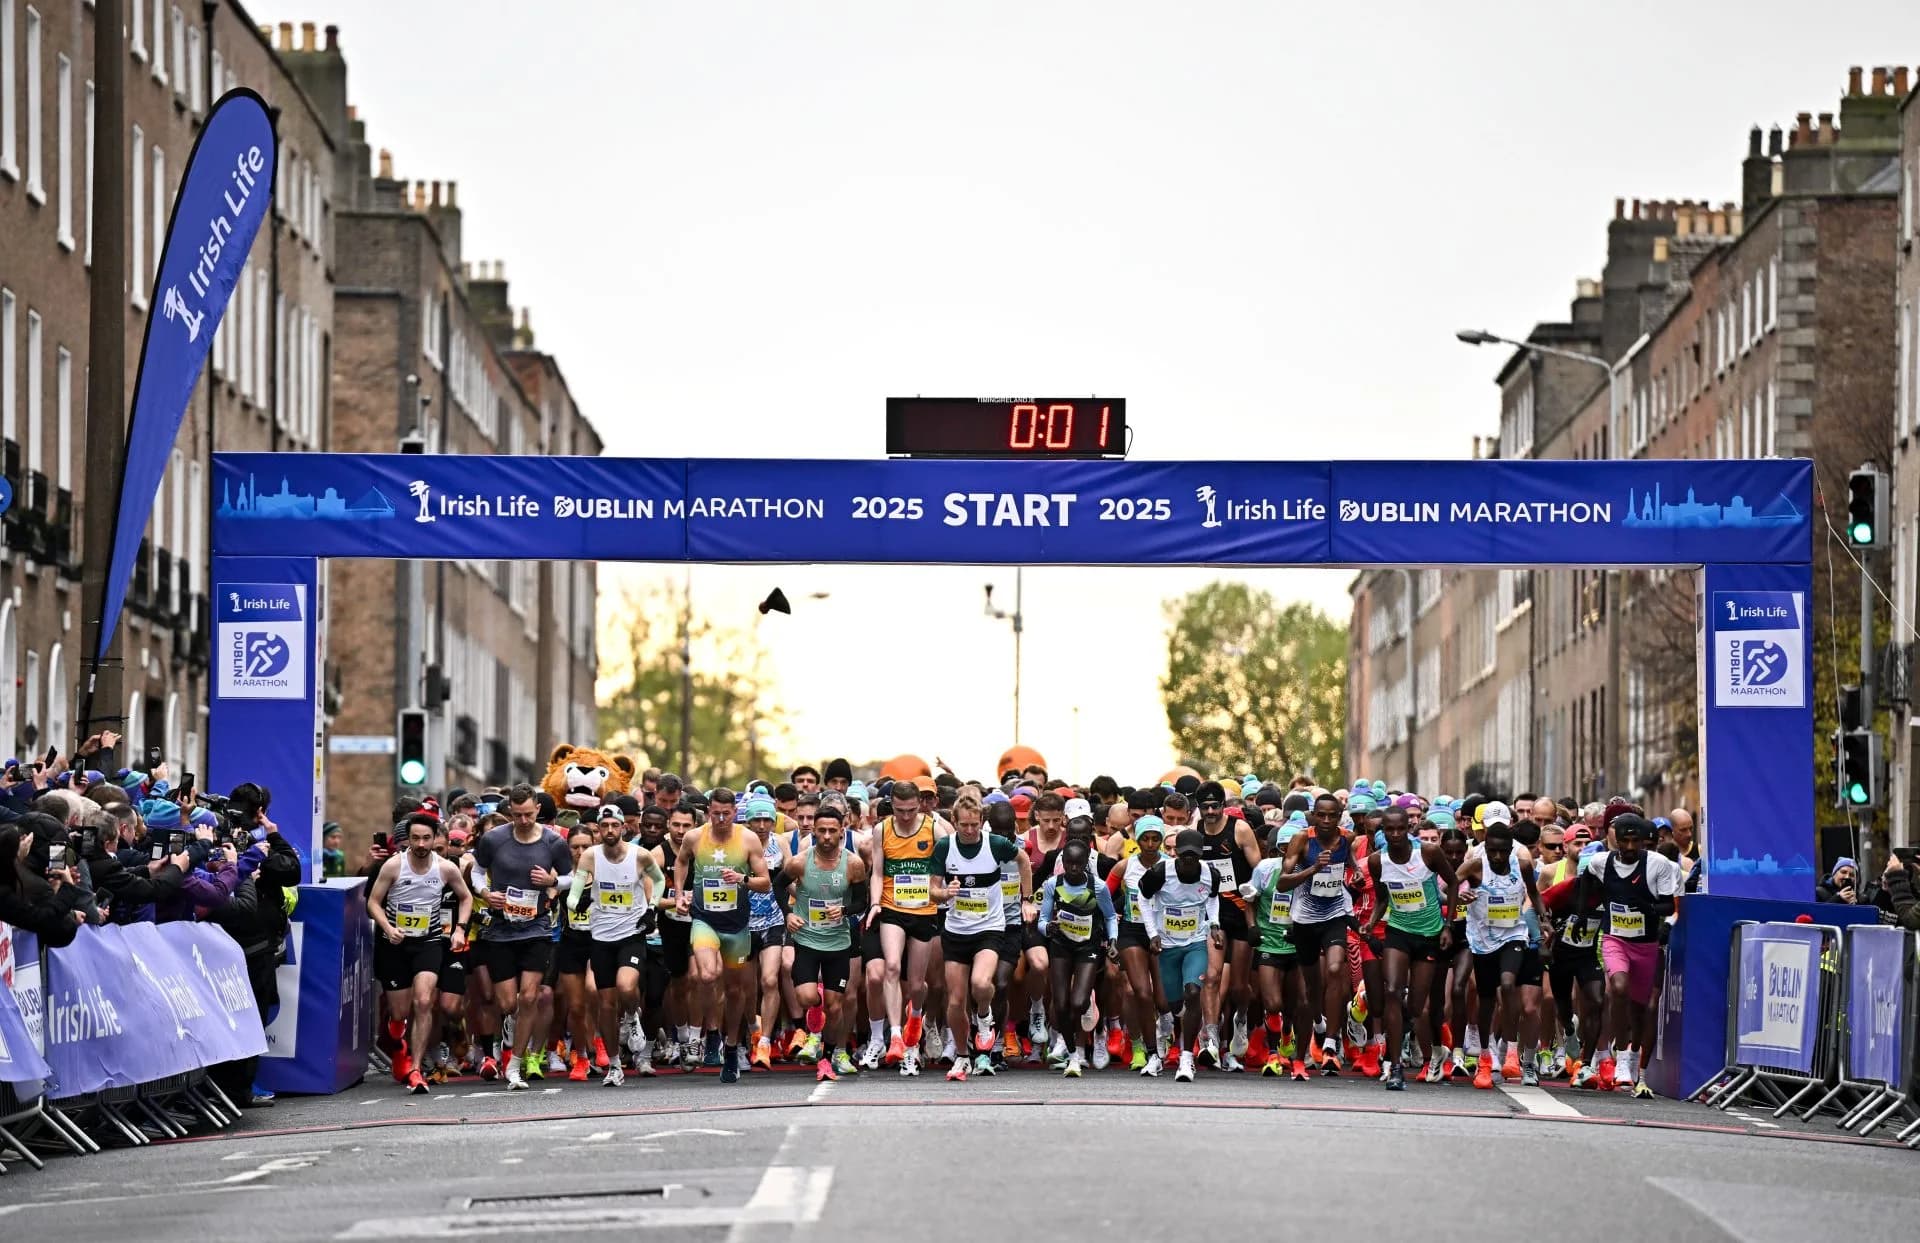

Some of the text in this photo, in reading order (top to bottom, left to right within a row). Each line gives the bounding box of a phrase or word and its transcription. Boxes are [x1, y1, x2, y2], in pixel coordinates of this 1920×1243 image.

[188, 145, 265, 298] Irish Life
[440, 492, 1611, 528] Irish Life DUBLIN MARATHON 2025 START 2025 Irish Life DUBLIN MARATHON
[243, 598, 291, 610] Irish Life
[1740, 606, 1788, 617] Irish Life
[233, 631, 244, 678] DUBLIN
[1730, 639, 1741, 686] DUBLIN
[233, 679, 288, 687] MARATHON
[1731, 687, 1787, 695] MARATHON
[1313, 879, 1342, 889] PACER
[608, 894, 624, 904] 41
[712, 891, 728, 902] 52
[1391, 890, 1423, 900] NGENO
[405, 916, 421, 928] 37
[1165, 917, 1196, 929] HASO
[1612, 914, 1643, 925] SIYUM
[48, 988, 91, 1045] Irish
